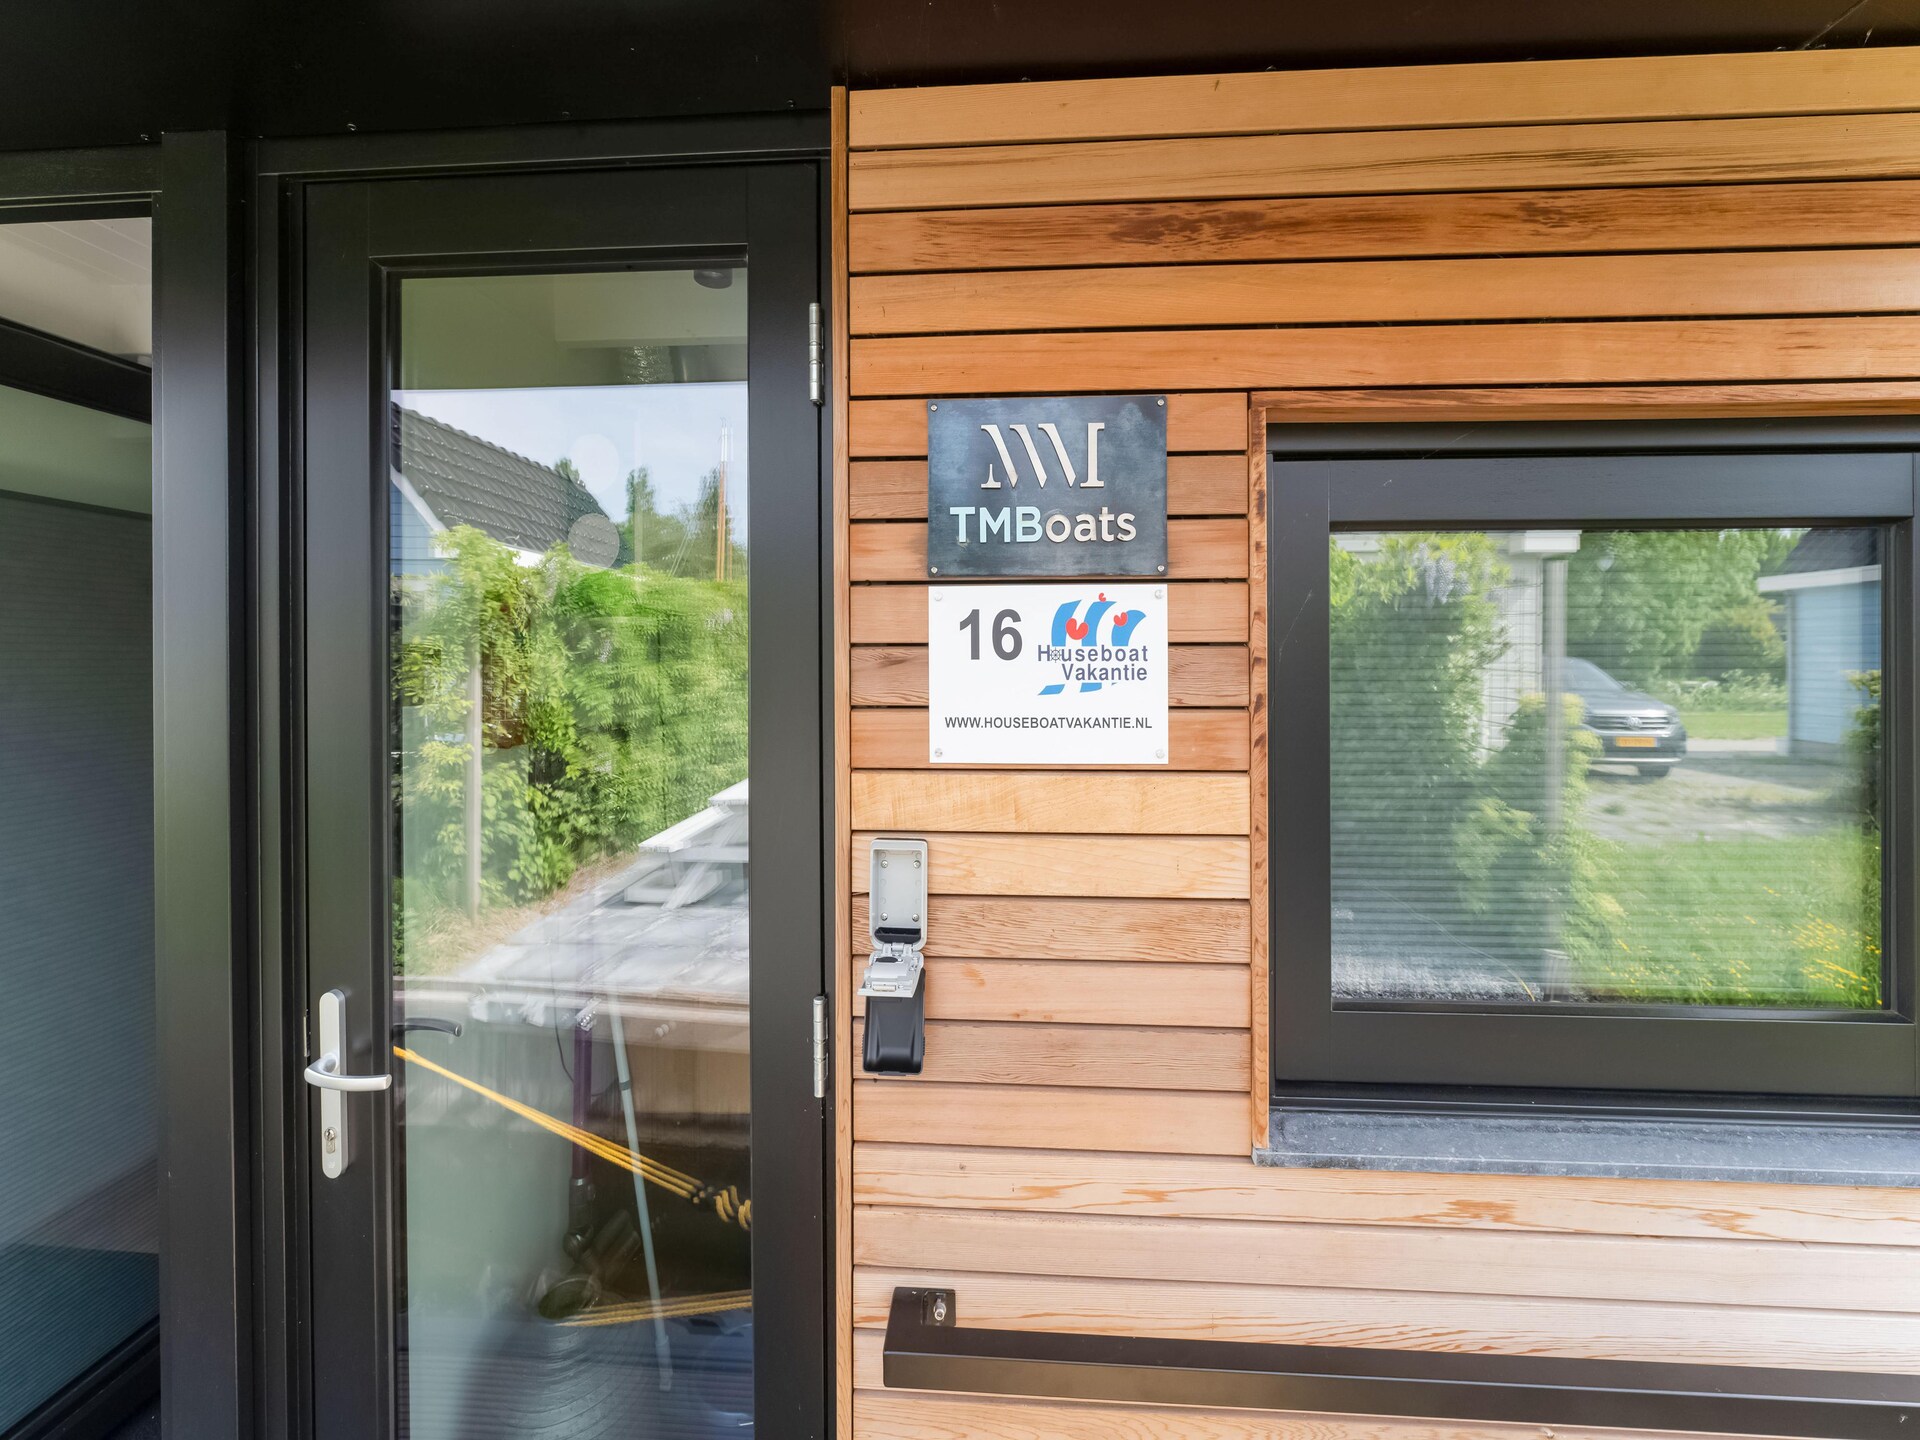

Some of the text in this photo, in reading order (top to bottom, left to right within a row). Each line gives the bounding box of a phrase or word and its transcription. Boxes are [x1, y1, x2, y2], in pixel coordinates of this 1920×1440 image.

[949, 506, 1137, 543] TMBoats
[959, 608, 1023, 661] 16
[1061, 663, 1148, 681] Vakantie
[944, 716, 1153, 729] WWW.HOUSEBOATVAKANTIE.NL
